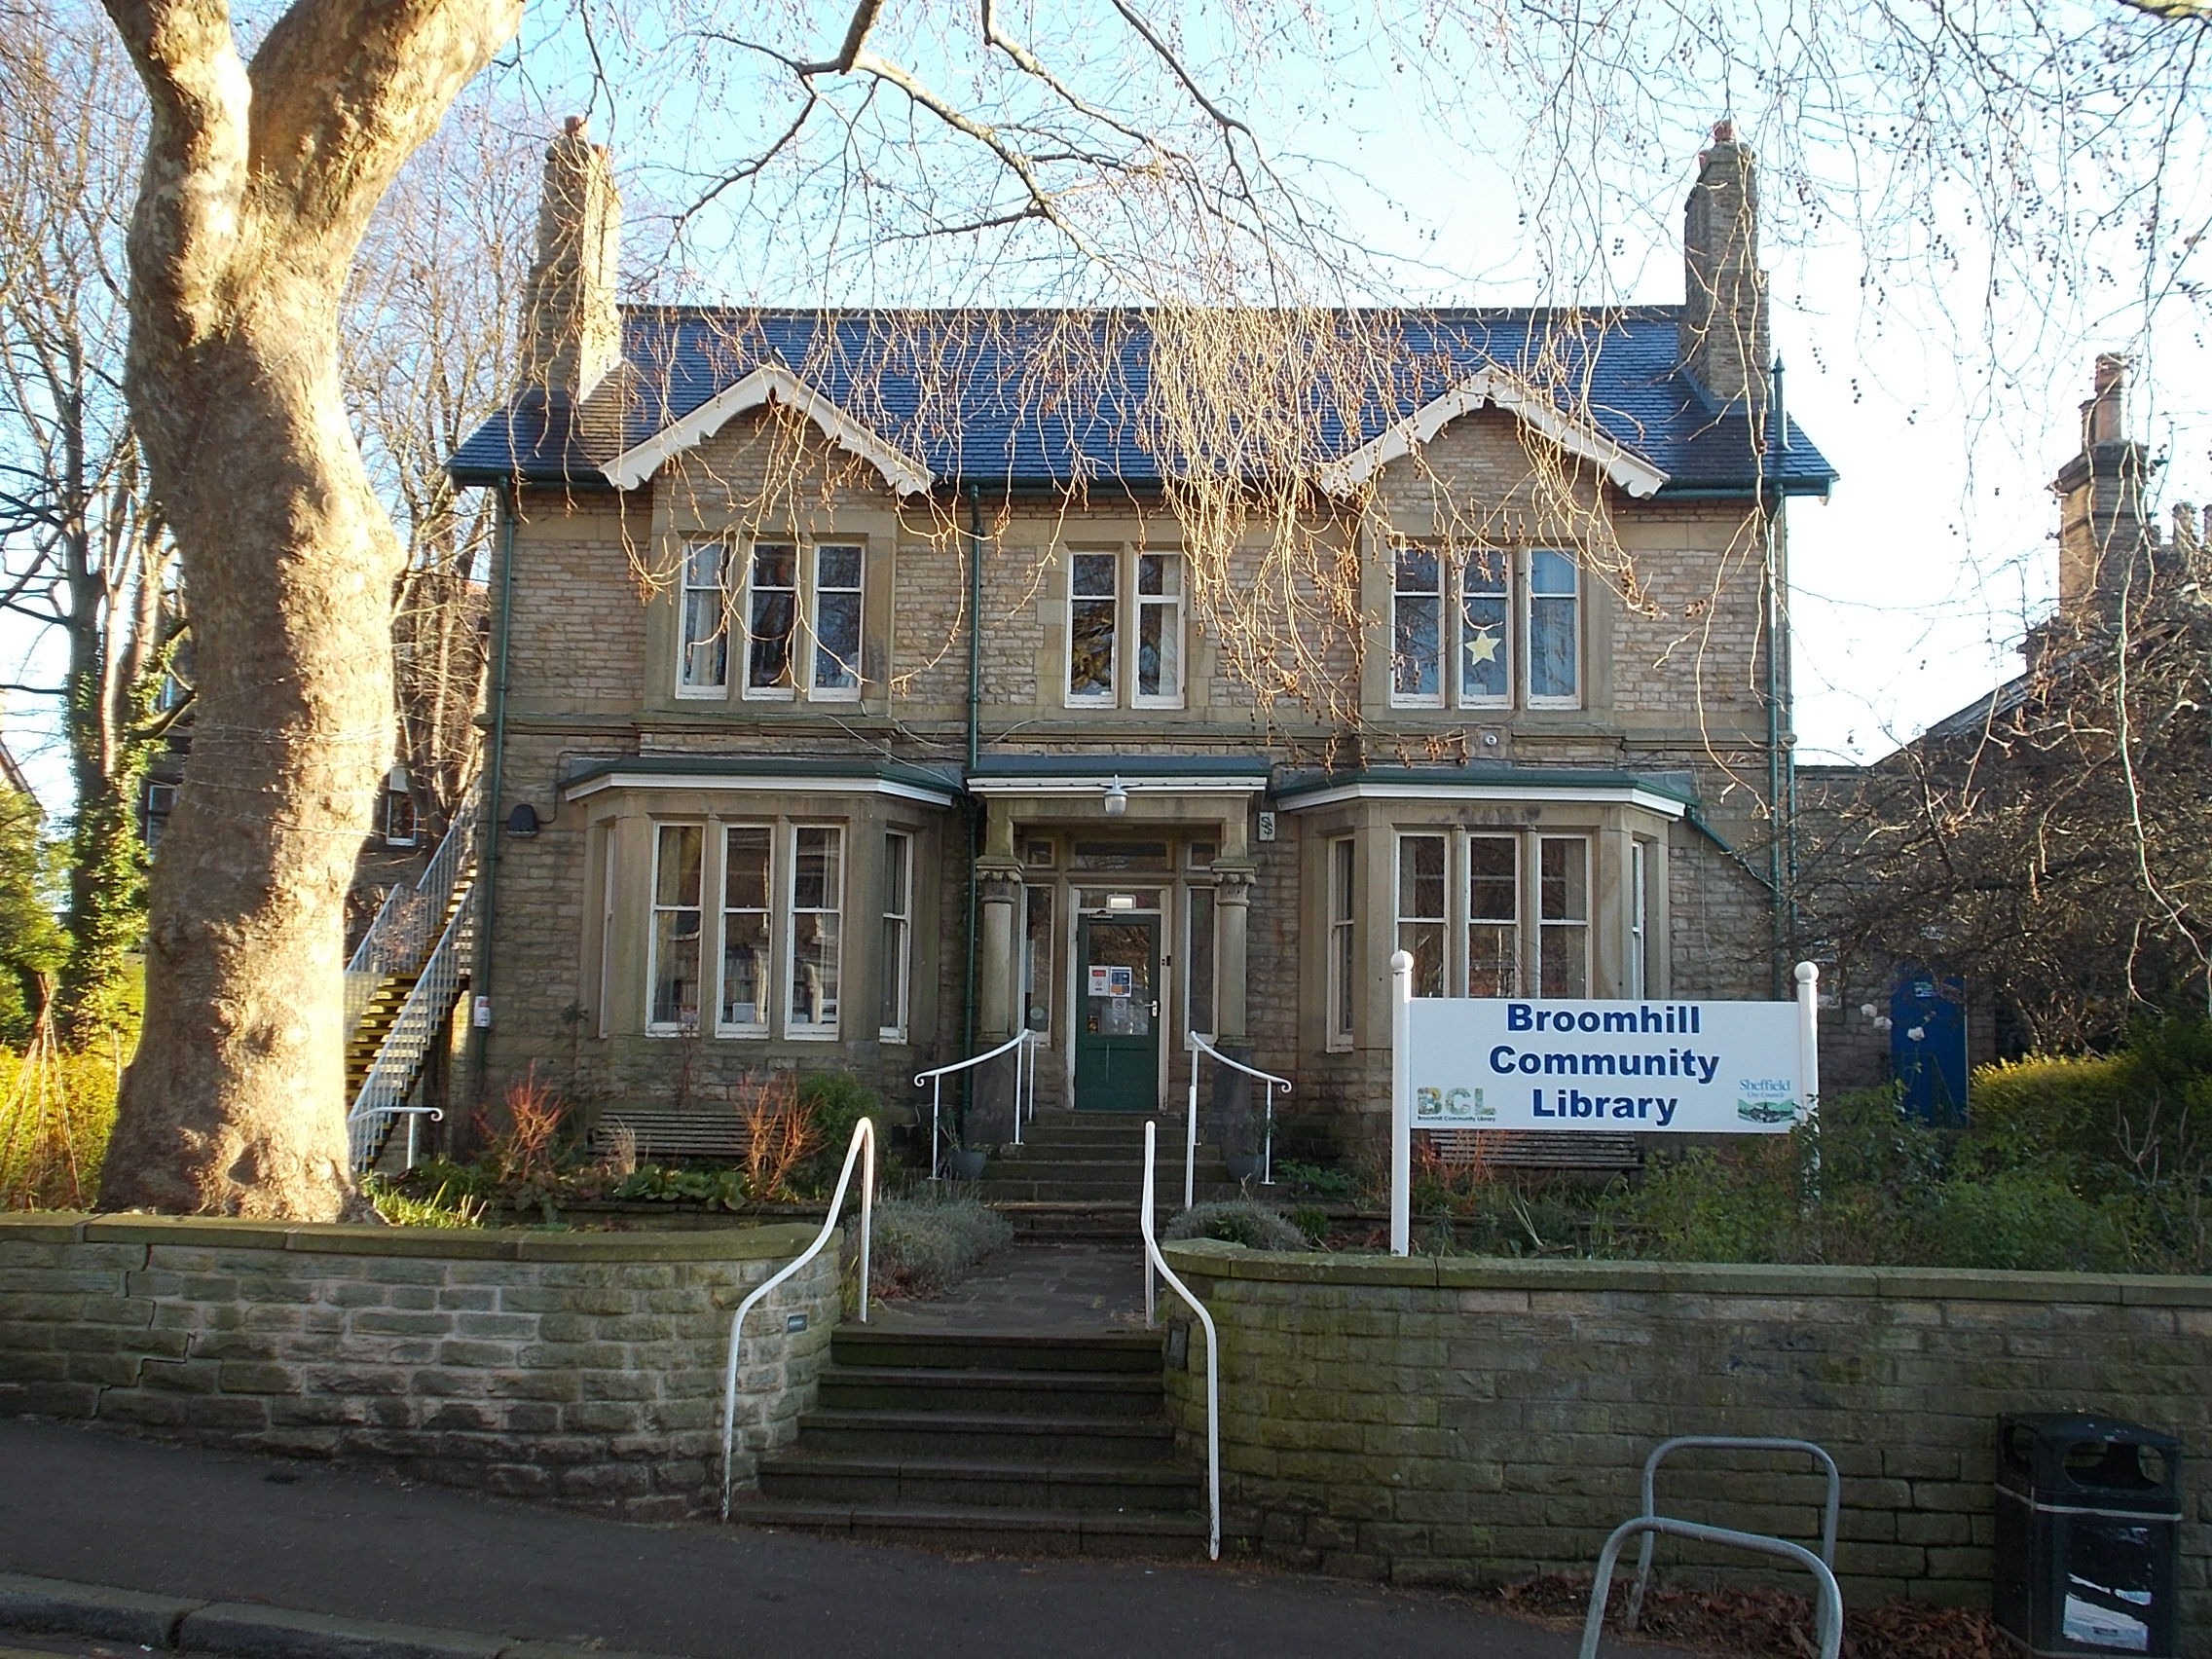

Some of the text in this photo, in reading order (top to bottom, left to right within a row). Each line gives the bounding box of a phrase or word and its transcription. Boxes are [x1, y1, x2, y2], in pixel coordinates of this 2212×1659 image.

[1507, 1004, 1700, 1034] Broomhill
[1490, 1046, 1719, 1085] Community
[1739, 1080, 1790, 1091] Sheffield
[1418, 1088, 1496, 1116] BCL
[1532, 1088, 1678, 1126] Library
